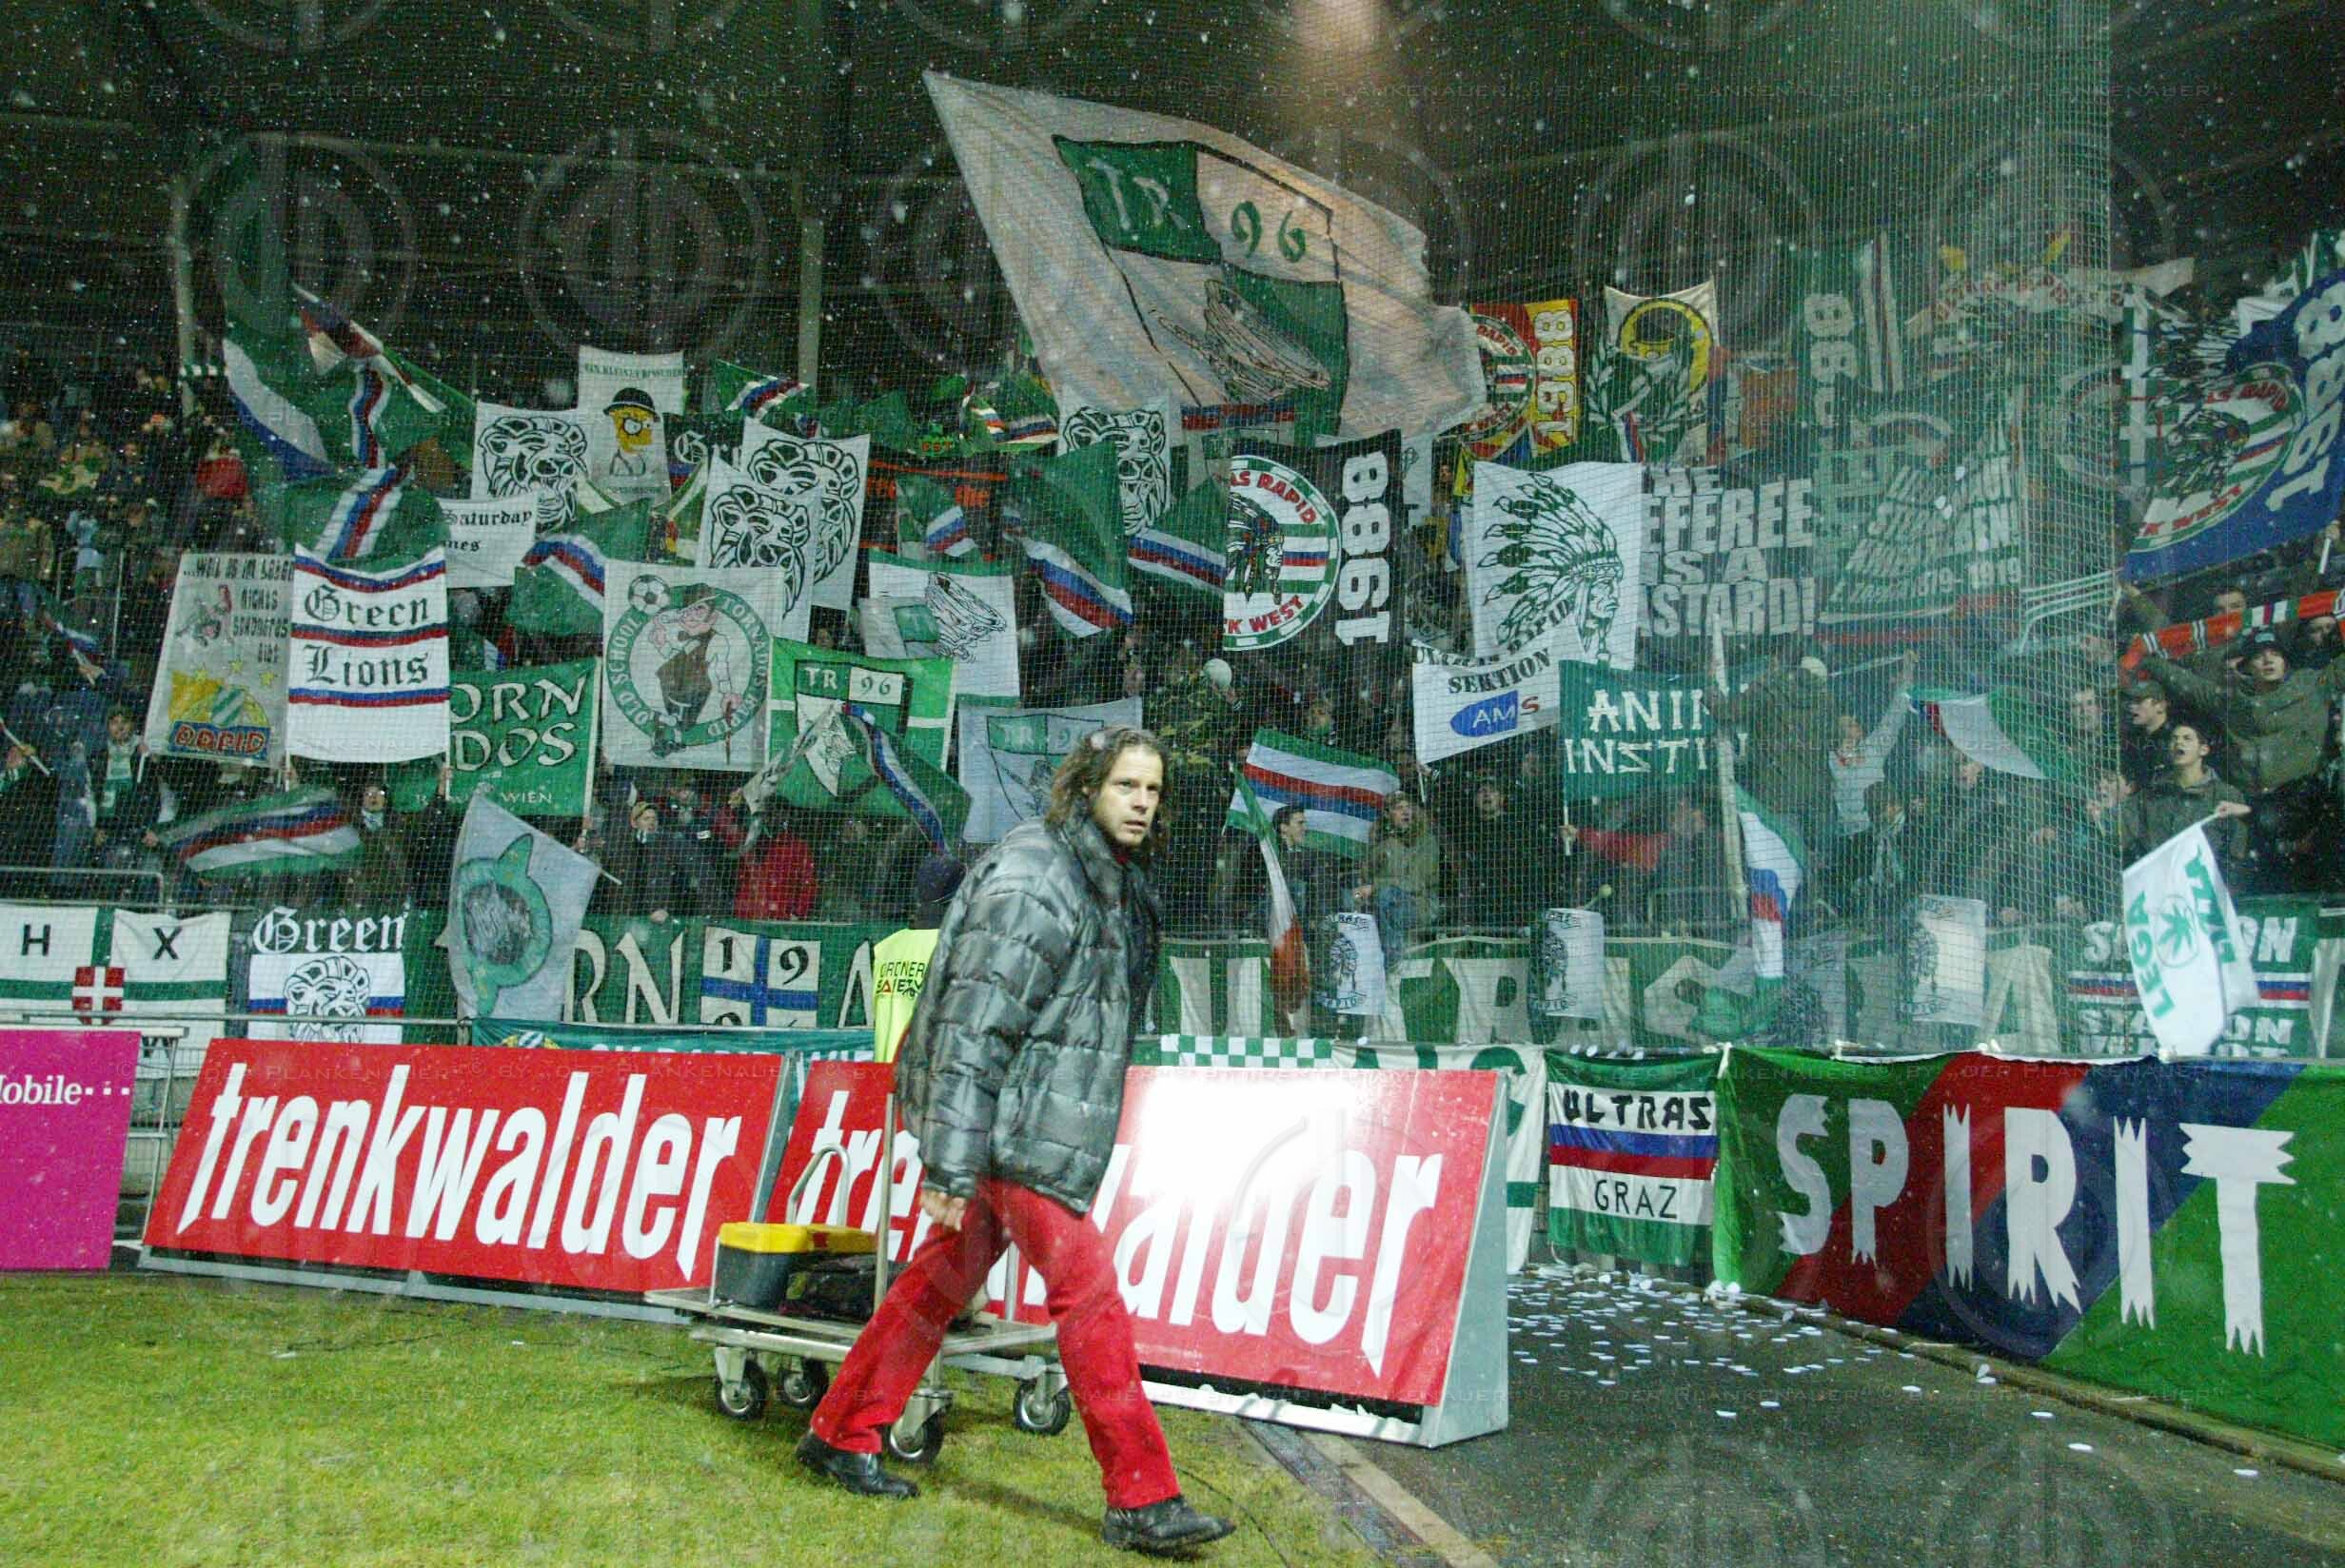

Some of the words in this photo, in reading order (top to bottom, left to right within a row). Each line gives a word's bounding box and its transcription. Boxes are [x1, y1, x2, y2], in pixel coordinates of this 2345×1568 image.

[1086, 156, 1190, 231] TR
[1232, 200, 1307, 263] 96
[1533, 309, 1577, 440] 1988
[442, 509, 533, 527] Saturday
[1256, 472, 1318, 525] RAPID
[1334, 450, 1391, 646] 1988
[1723, 546, 1768, 583] A
[304, 583, 429, 626] Green
[1248, 594, 1305, 634] WEST
[304, 643, 429, 688] Lions
[608, 617, 641, 684] SCHOOL
[1448, 648, 1551, 694] SEKTION
[804, 666, 838, 691] TR
[860, 676, 891, 695] 96
[619, 690, 655, 727] OLD
[1472, 696, 1540, 729] AMS
[499, 791, 552, 804] WIEN
[21, 923, 51, 956] H
[152, 925, 182, 960] X
[251, 905, 409, 953] Green
[2126, 890, 2176, 1019] LEGA
[0, 1074, 82, 1106] obile
[1563, 1088, 1712, 1132] ULTRAS
[178, 1061, 743, 1283] trenkwalder
[1593, 1182, 1678, 1221] GRAZ
[1776, 1092, 2296, 1358] SPIRIT
